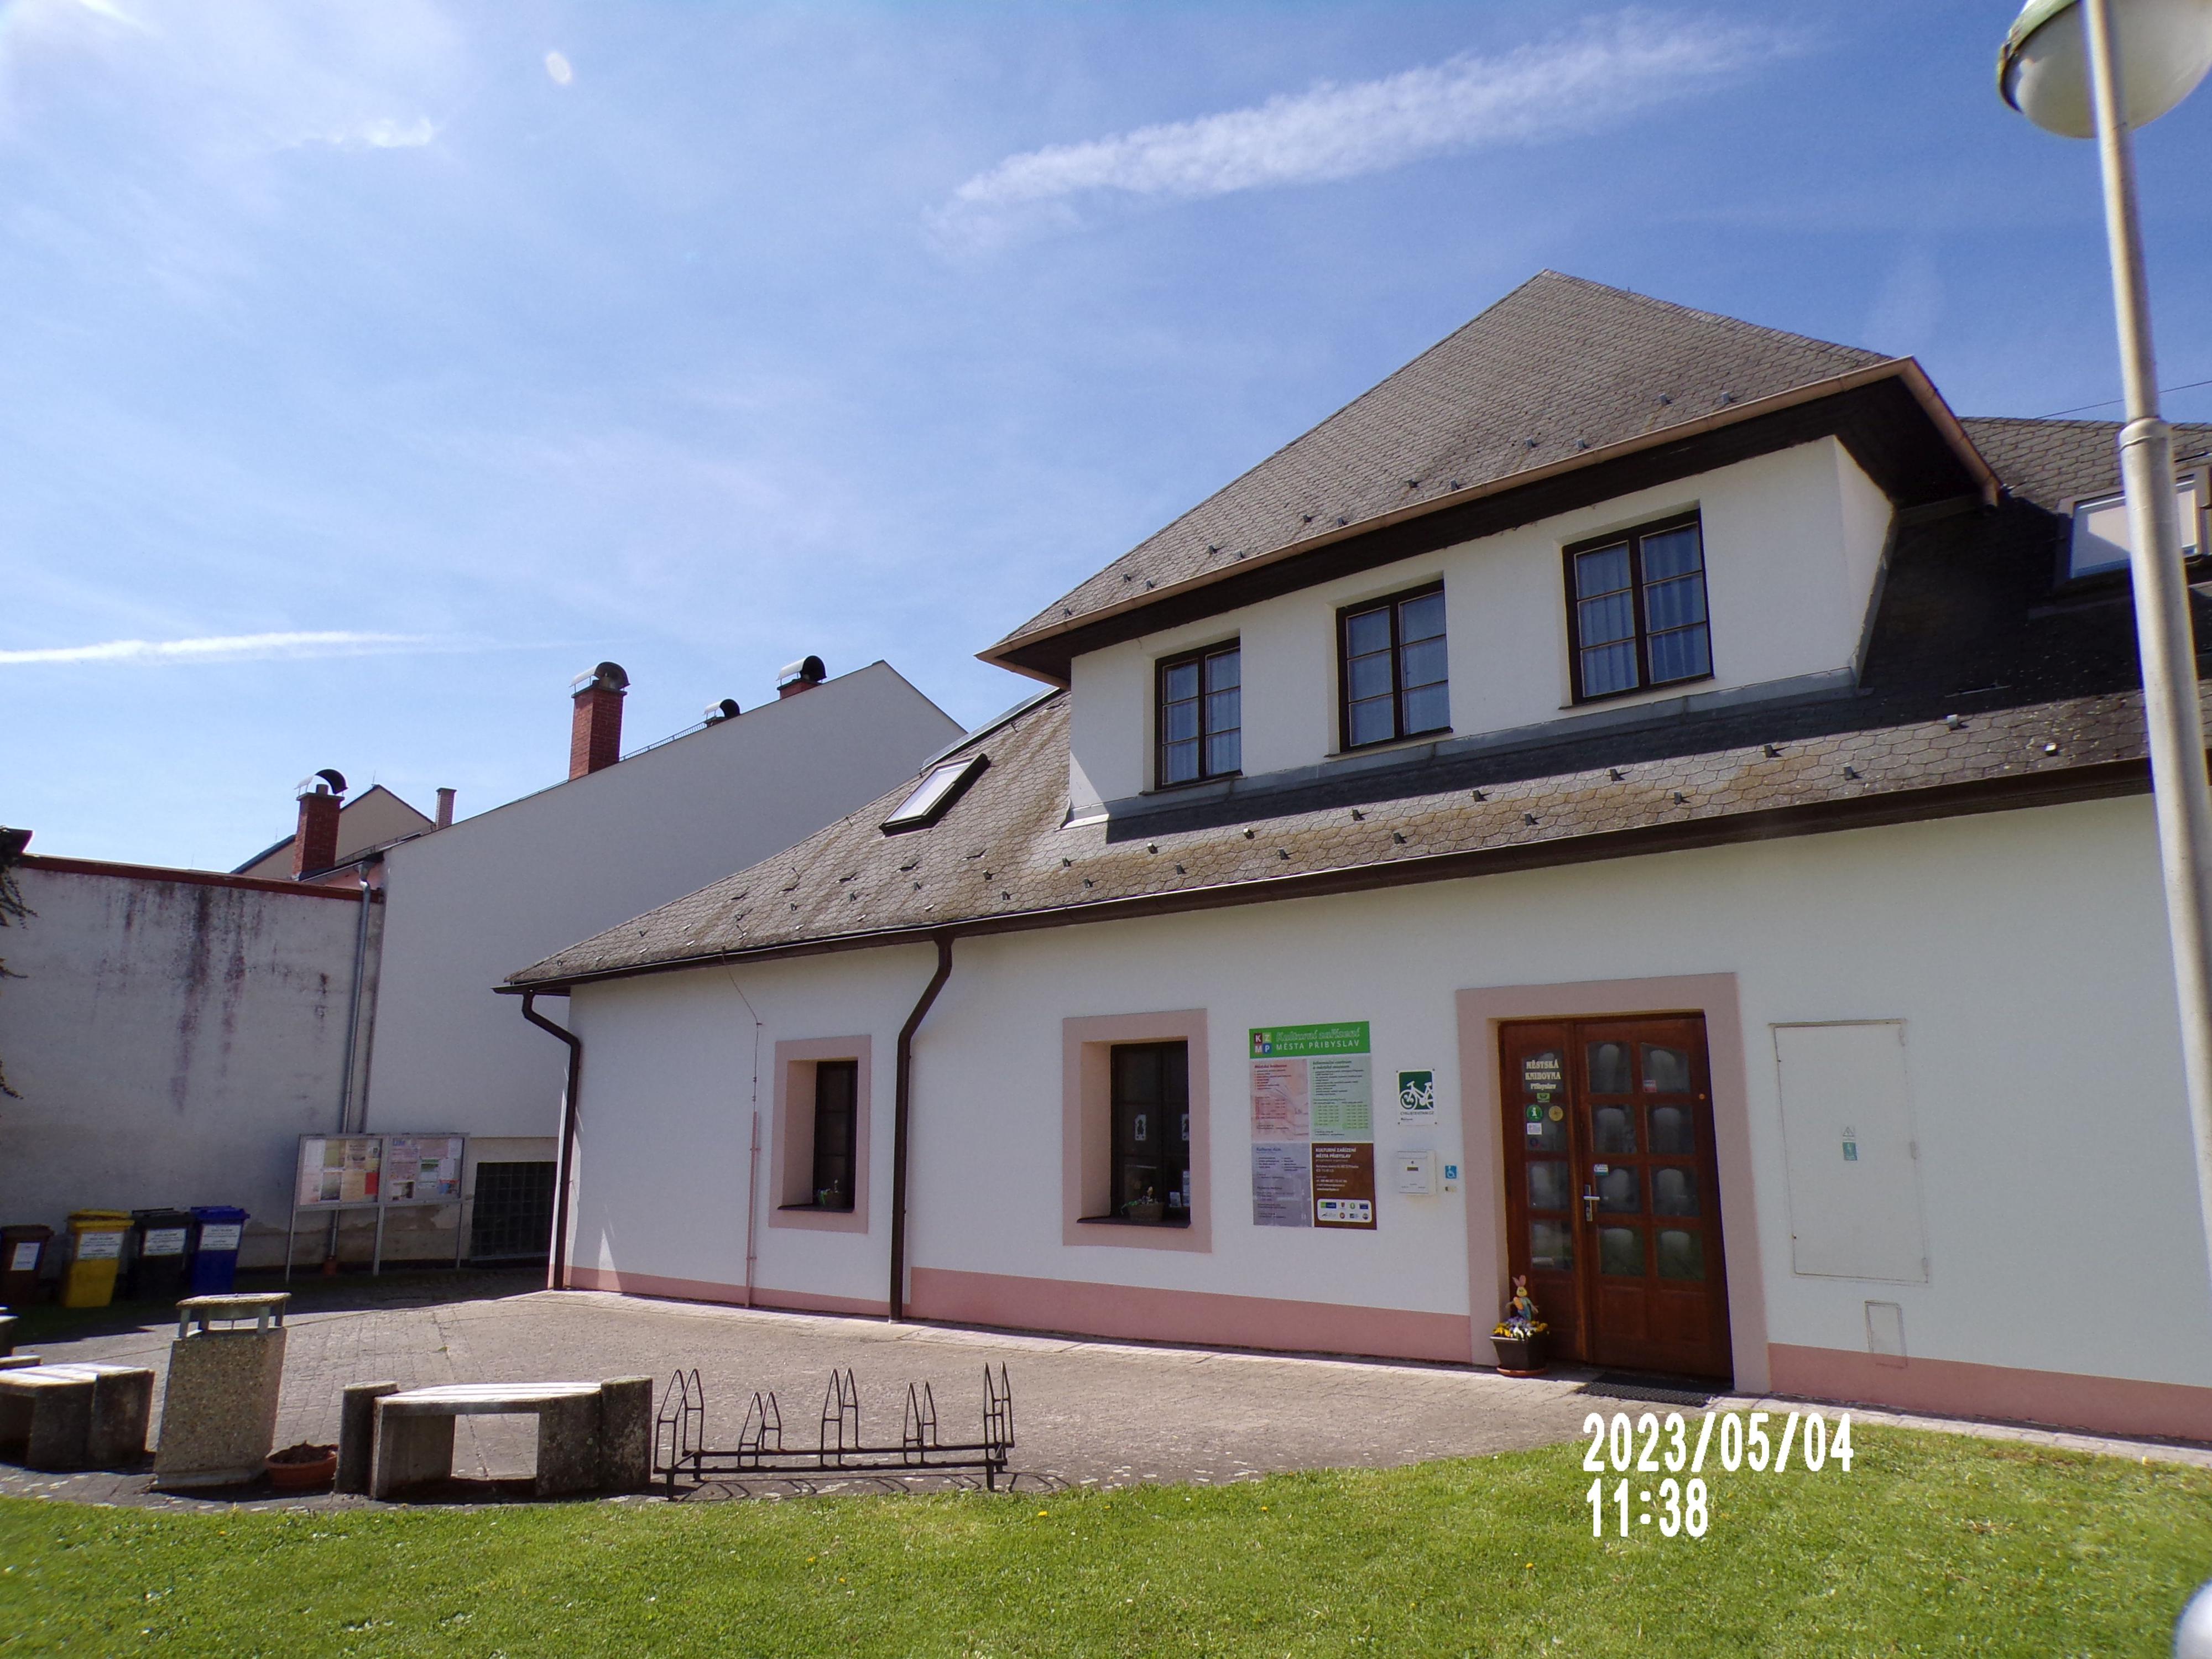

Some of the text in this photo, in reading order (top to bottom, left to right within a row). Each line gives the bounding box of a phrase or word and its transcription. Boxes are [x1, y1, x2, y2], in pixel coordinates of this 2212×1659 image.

[1308, 1039, 1360, 1049] PŘIBYSLAV
[1526, 1058, 1559, 1070] MĚSTSKÁ
[1525, 1072, 1561, 1080] KNIHOVNA
